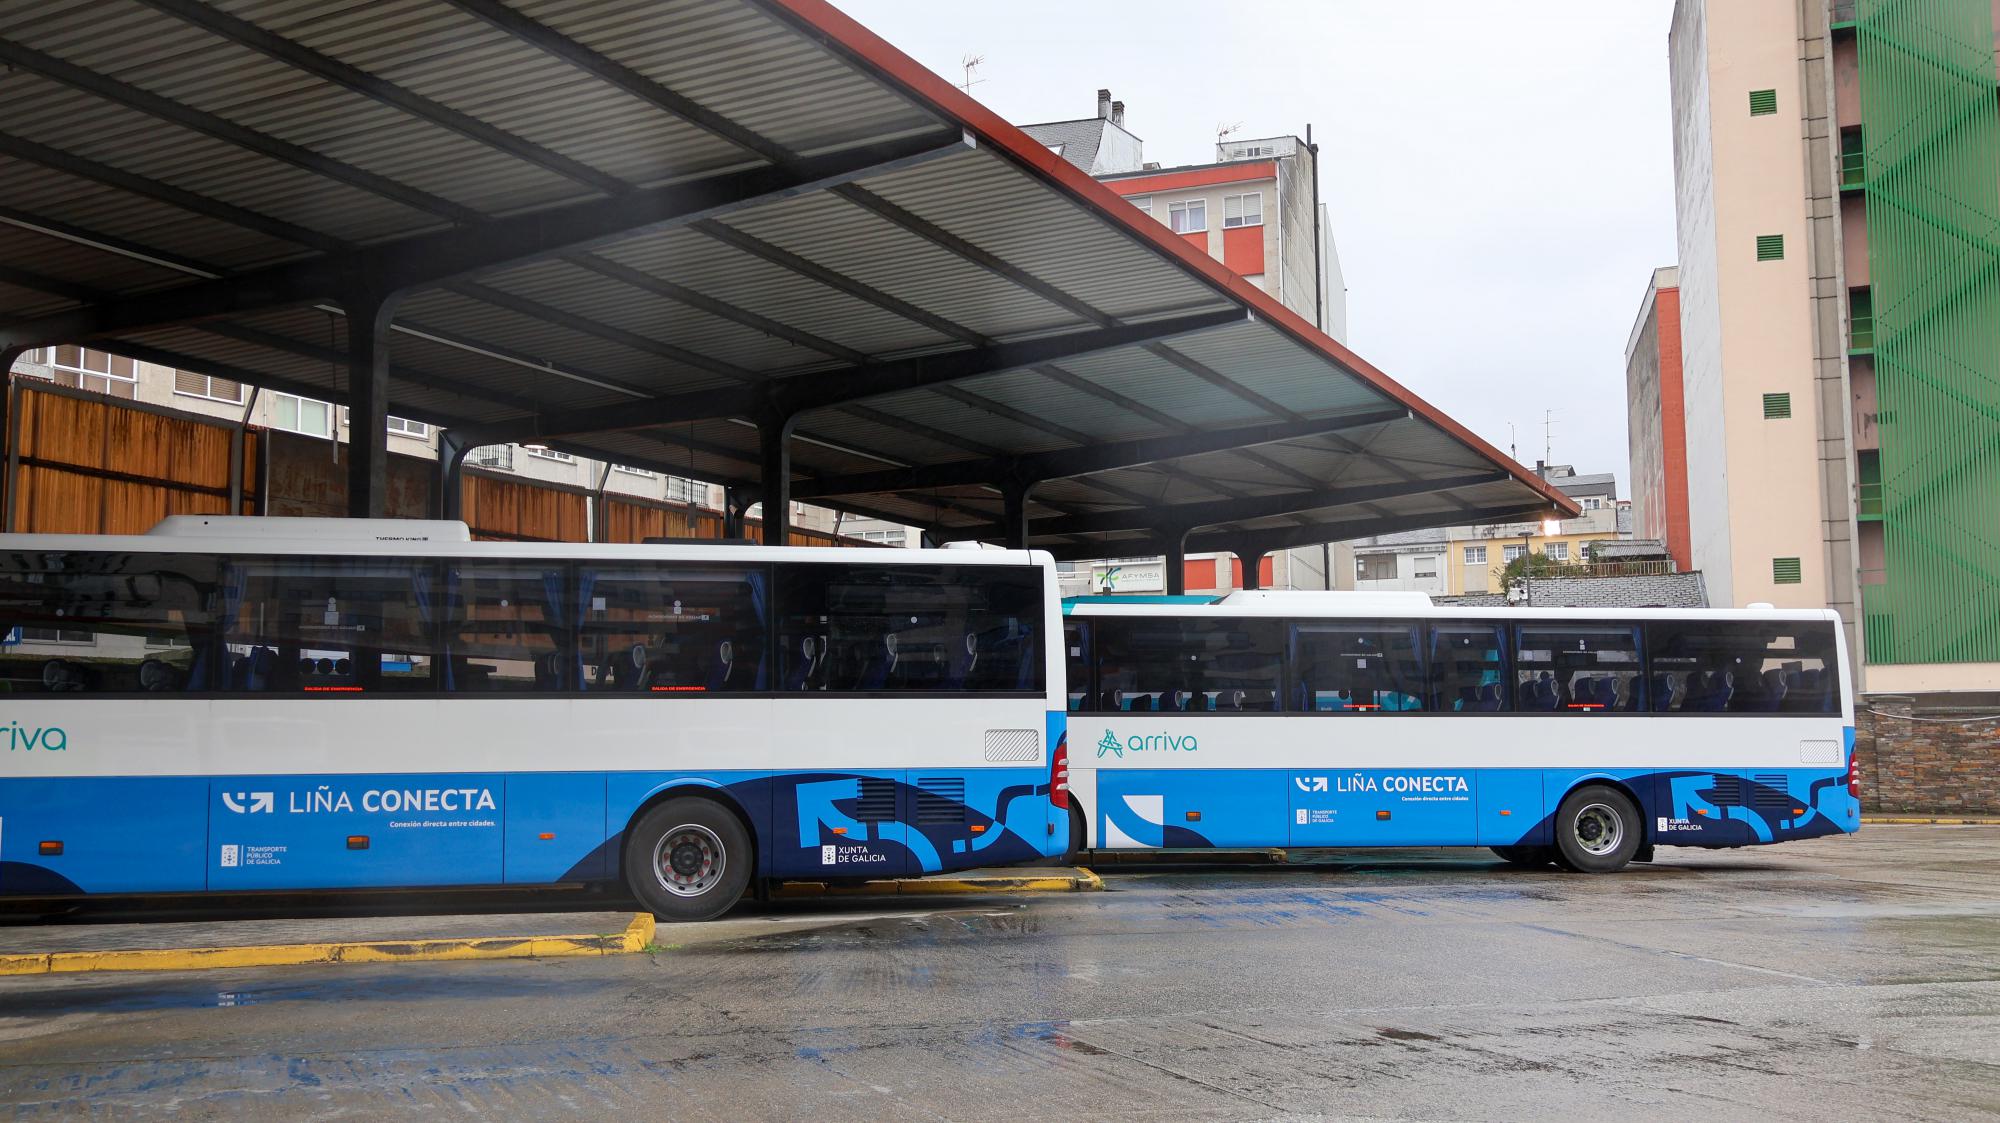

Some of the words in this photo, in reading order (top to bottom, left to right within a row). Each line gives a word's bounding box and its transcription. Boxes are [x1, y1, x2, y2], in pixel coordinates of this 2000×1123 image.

[1128, 731, 1198, 751] arriva
[1337, 773, 1377, 791] LIÑA
[1382, 776, 1469, 792] CONECTA
[289, 786, 353, 813] LIÑA
[362, 788, 496, 812] CONECTA
[389, 820, 421, 828] Conexión
[422, 820, 447, 828] directa
